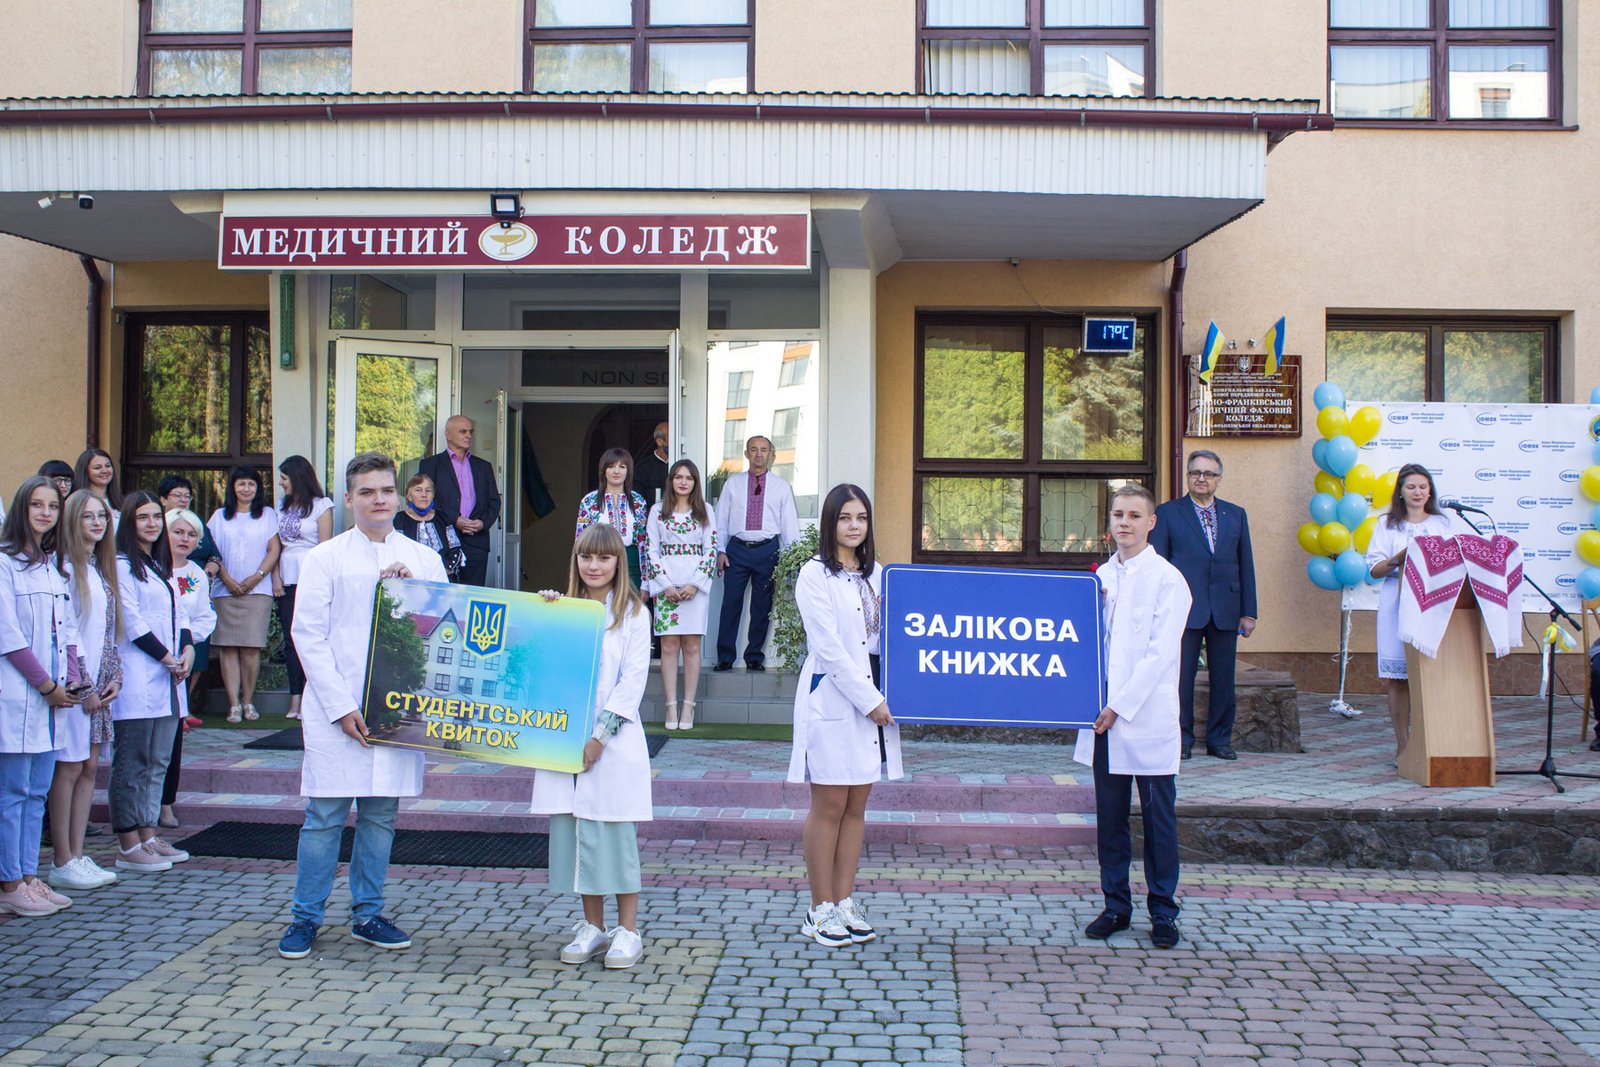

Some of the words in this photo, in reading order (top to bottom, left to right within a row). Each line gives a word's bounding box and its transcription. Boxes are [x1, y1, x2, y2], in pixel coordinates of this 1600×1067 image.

[231, 221, 469, 262] МЕДИЧНИЙ
[564, 225, 779, 262] КОЛЕДЖ
[582, 371, 634, 384] NON
[1225, 414, 1264, 423] КОЛЕДЖ
[1249, 406, 1293, 415] ФАХОВИЙ
[904, 612, 1080, 643] ЗАЛІКОВА
[918, 649, 1067, 678] КНИЖКА
[385, 690, 568, 732] СТУДЕНТСЬКИЙ
[426, 719, 520, 750] КВИТОК
